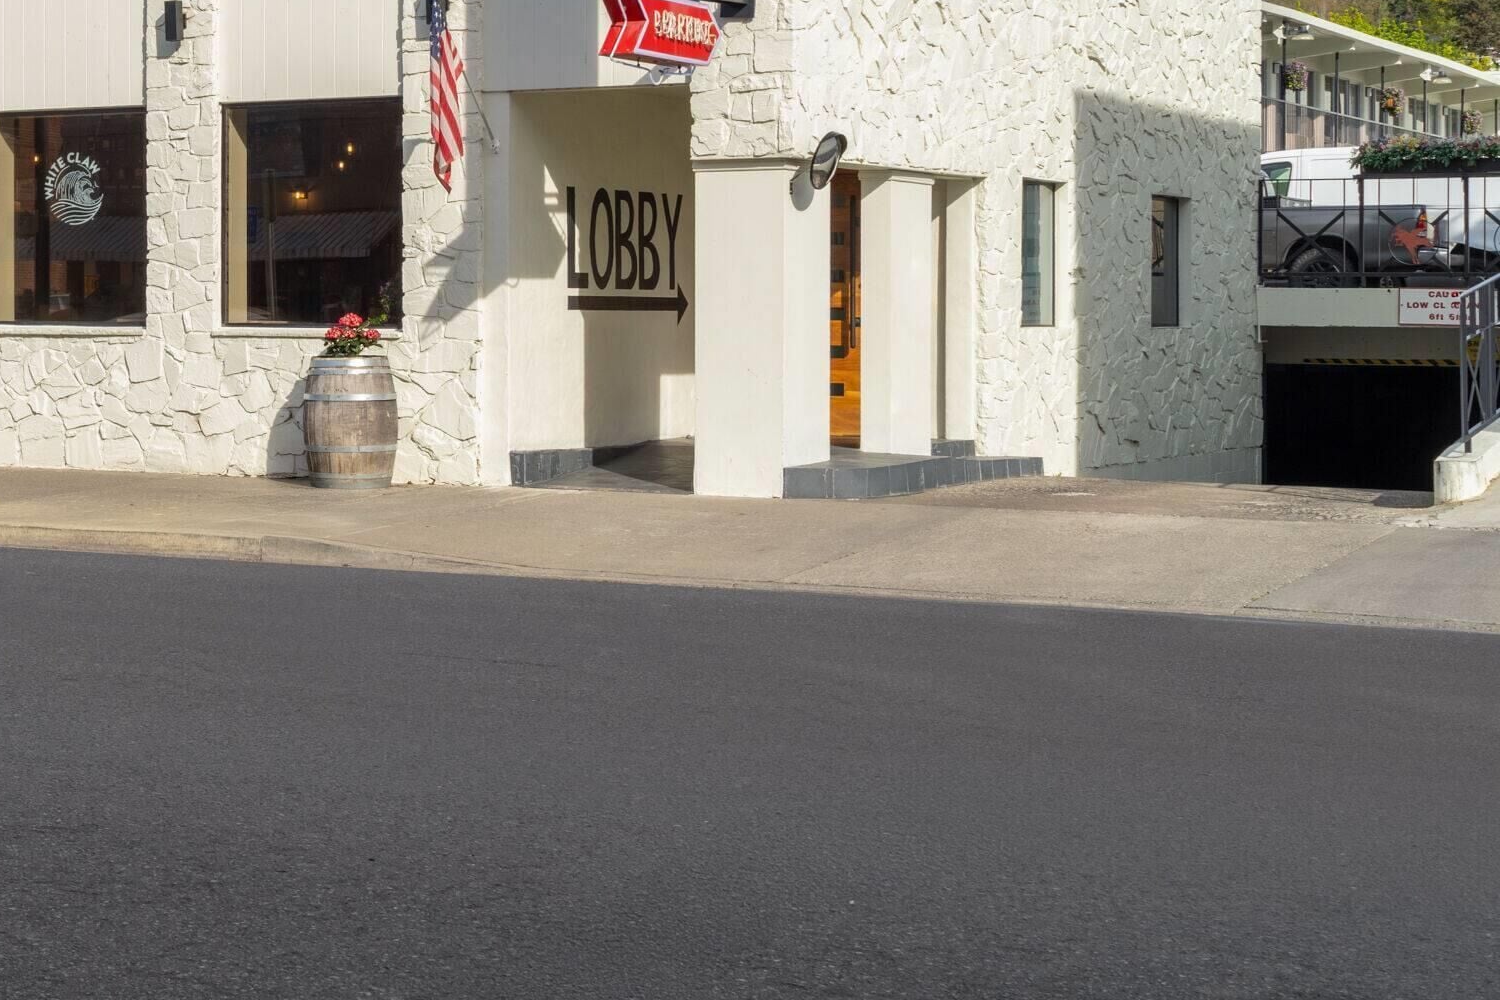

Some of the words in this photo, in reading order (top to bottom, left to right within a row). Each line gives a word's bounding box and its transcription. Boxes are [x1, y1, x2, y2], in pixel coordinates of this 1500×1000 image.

[44, 156, 66, 201] WHITE
[66, 151, 101, 175] CLAW
[566, 186, 683, 290] LOBBY
[1428, 313, 1444, 321] 6ft
